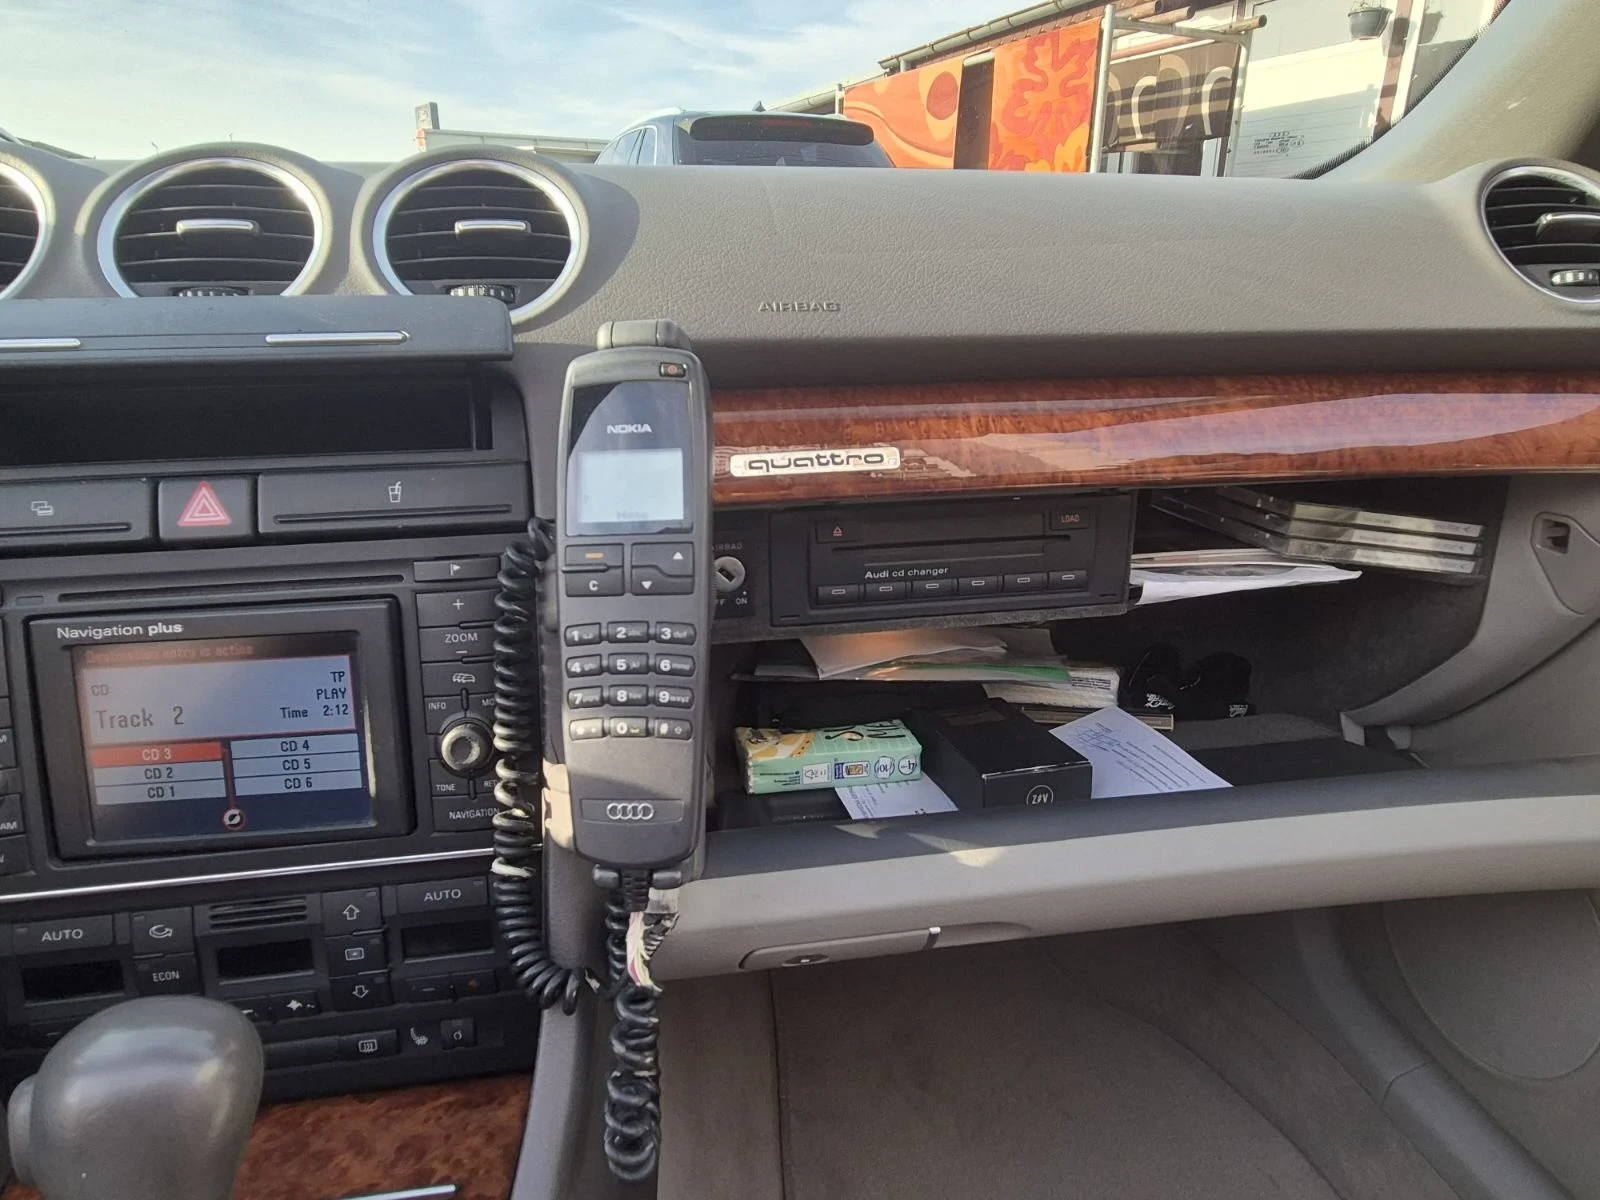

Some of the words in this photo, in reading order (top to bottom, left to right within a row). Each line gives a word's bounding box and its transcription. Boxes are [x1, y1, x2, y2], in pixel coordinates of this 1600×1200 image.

[758, 301, 841, 312] AIRBAG
[606, 423, 652, 434] NOKIA
[748, 453, 884, 472] quattro
[864, 570, 889, 580] Audi
[892, 569, 905, 578] cd
[907, 567, 949, 577] changer
[588, 580, 600, 591] C
[56, 624, 143, 640] Navigation
[148, 622, 185, 637] plus
[444, 632, 478, 643] ZOOM
[571, 630, 579, 641] 1
[616, 626, 627, 639] 2
[660, 627, 671, 640] 3
[570, 661, 582, 673] 4
[616, 659, 627, 671] 5
[660, 659, 671, 671] 6
[330, 671, 345, 682] TP
[91, 684, 109, 697] CD
[316, 687, 347, 700] PLAY
[616, 690, 628, 702] 8
[659, 690, 670, 703] 9
[481, 698, 496, 707] MO
[574, 693, 584, 705] 7
[280, 706, 309, 719] Time
[322, 703, 349, 717] 2:12
[428, 701, 447, 711] INFO
[96, 708, 153, 729] Track
[172, 706, 184, 725] 2
[280, 740, 298, 752] CD
[302, 739, 310, 751] 4
[142, 749, 159, 761] CD
[163, 747, 172, 759] 3
[282, 758, 300, 771] CD
[303, 757, 311, 770] 5
[144, 767, 162, 780] CD
[165, 766, 174, 779] 2
[284, 777, 302, 789] CD
[305, 776, 313, 788] 6
[436, 784, 456, 792] TONE
[147, 786, 165, 799] CD
[169, 785, 176, 797] 1
[448, 807, 500, 820] NAVIGATION
[423, 888, 462, 902] AUTO
[41, 928, 83, 942] AUTO
[152, 969, 180, 982] ECON
